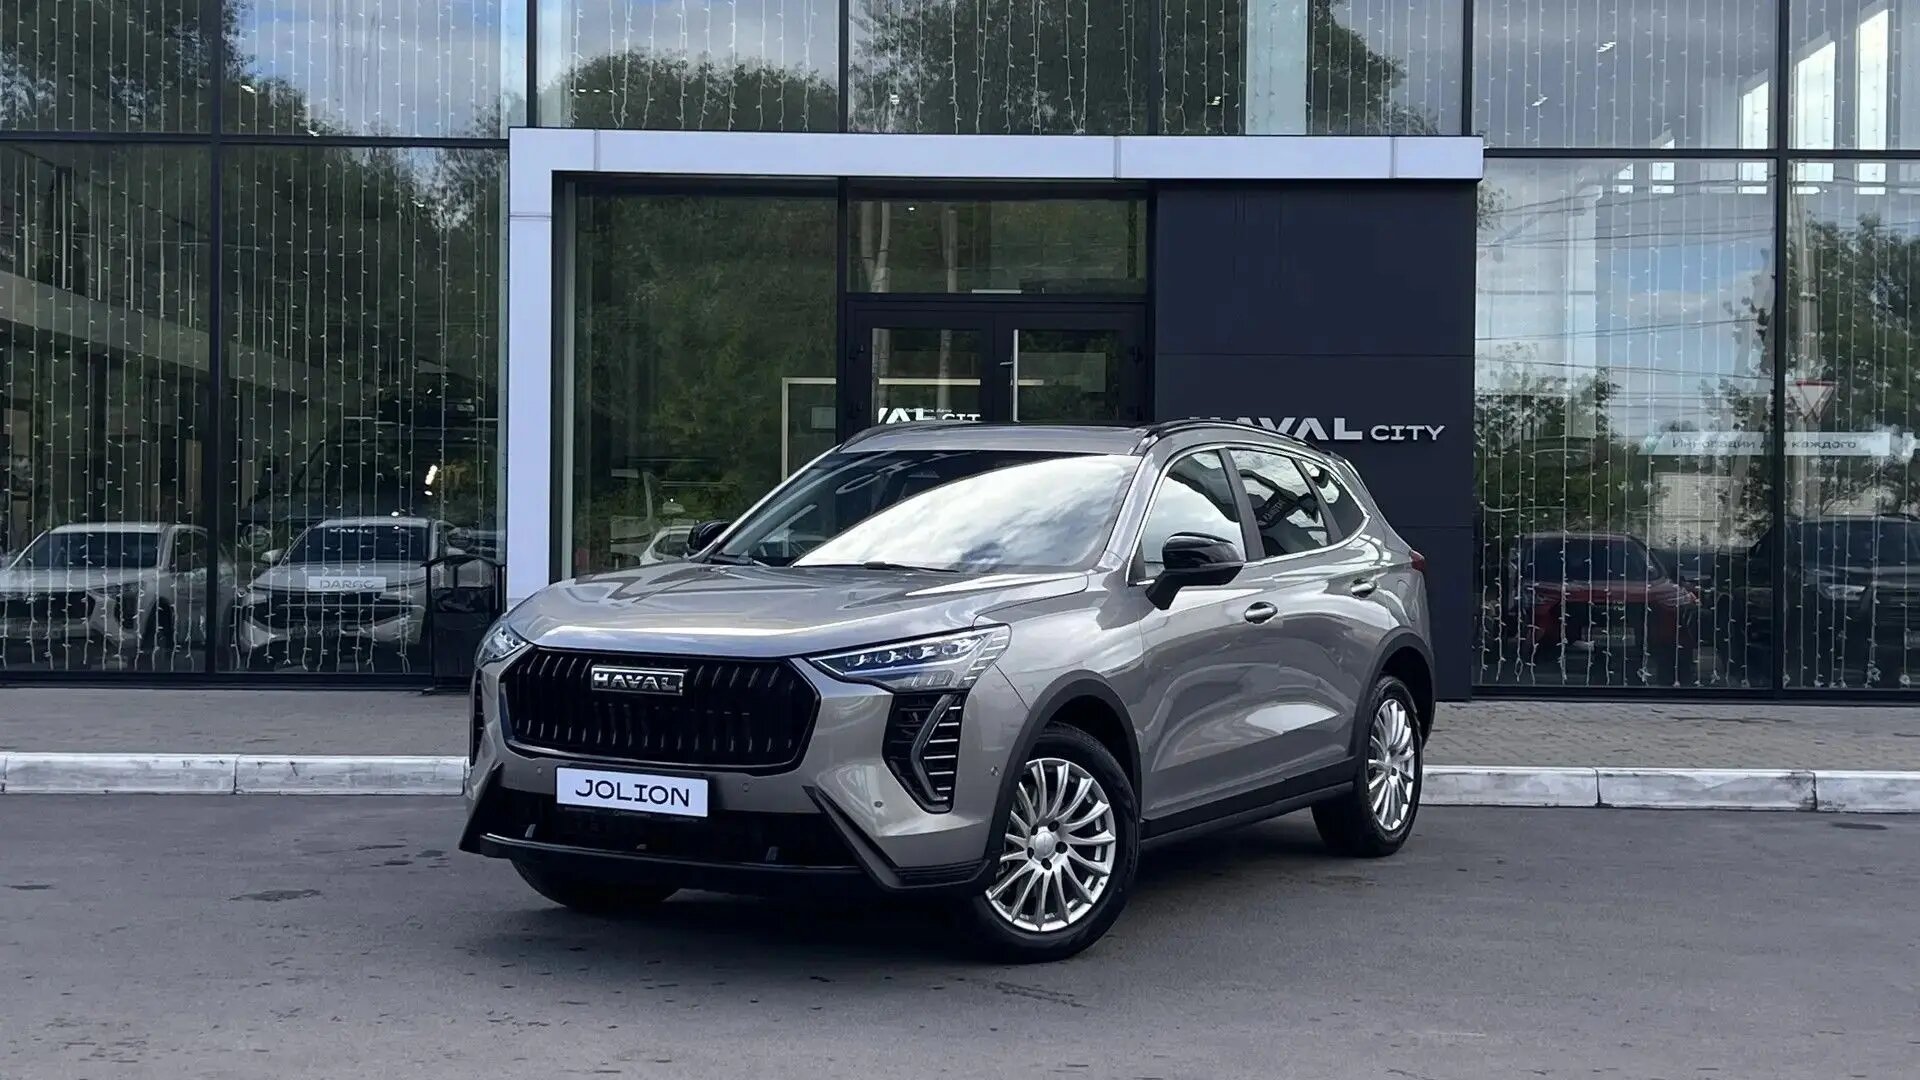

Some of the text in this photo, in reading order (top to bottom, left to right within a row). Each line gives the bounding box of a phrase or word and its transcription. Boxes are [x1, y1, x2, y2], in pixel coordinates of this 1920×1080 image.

[1190, 417, 1446, 441] VAL CITY
[593, 672, 678, 692] HAVAL
[575, 779, 690, 807] JOLION
